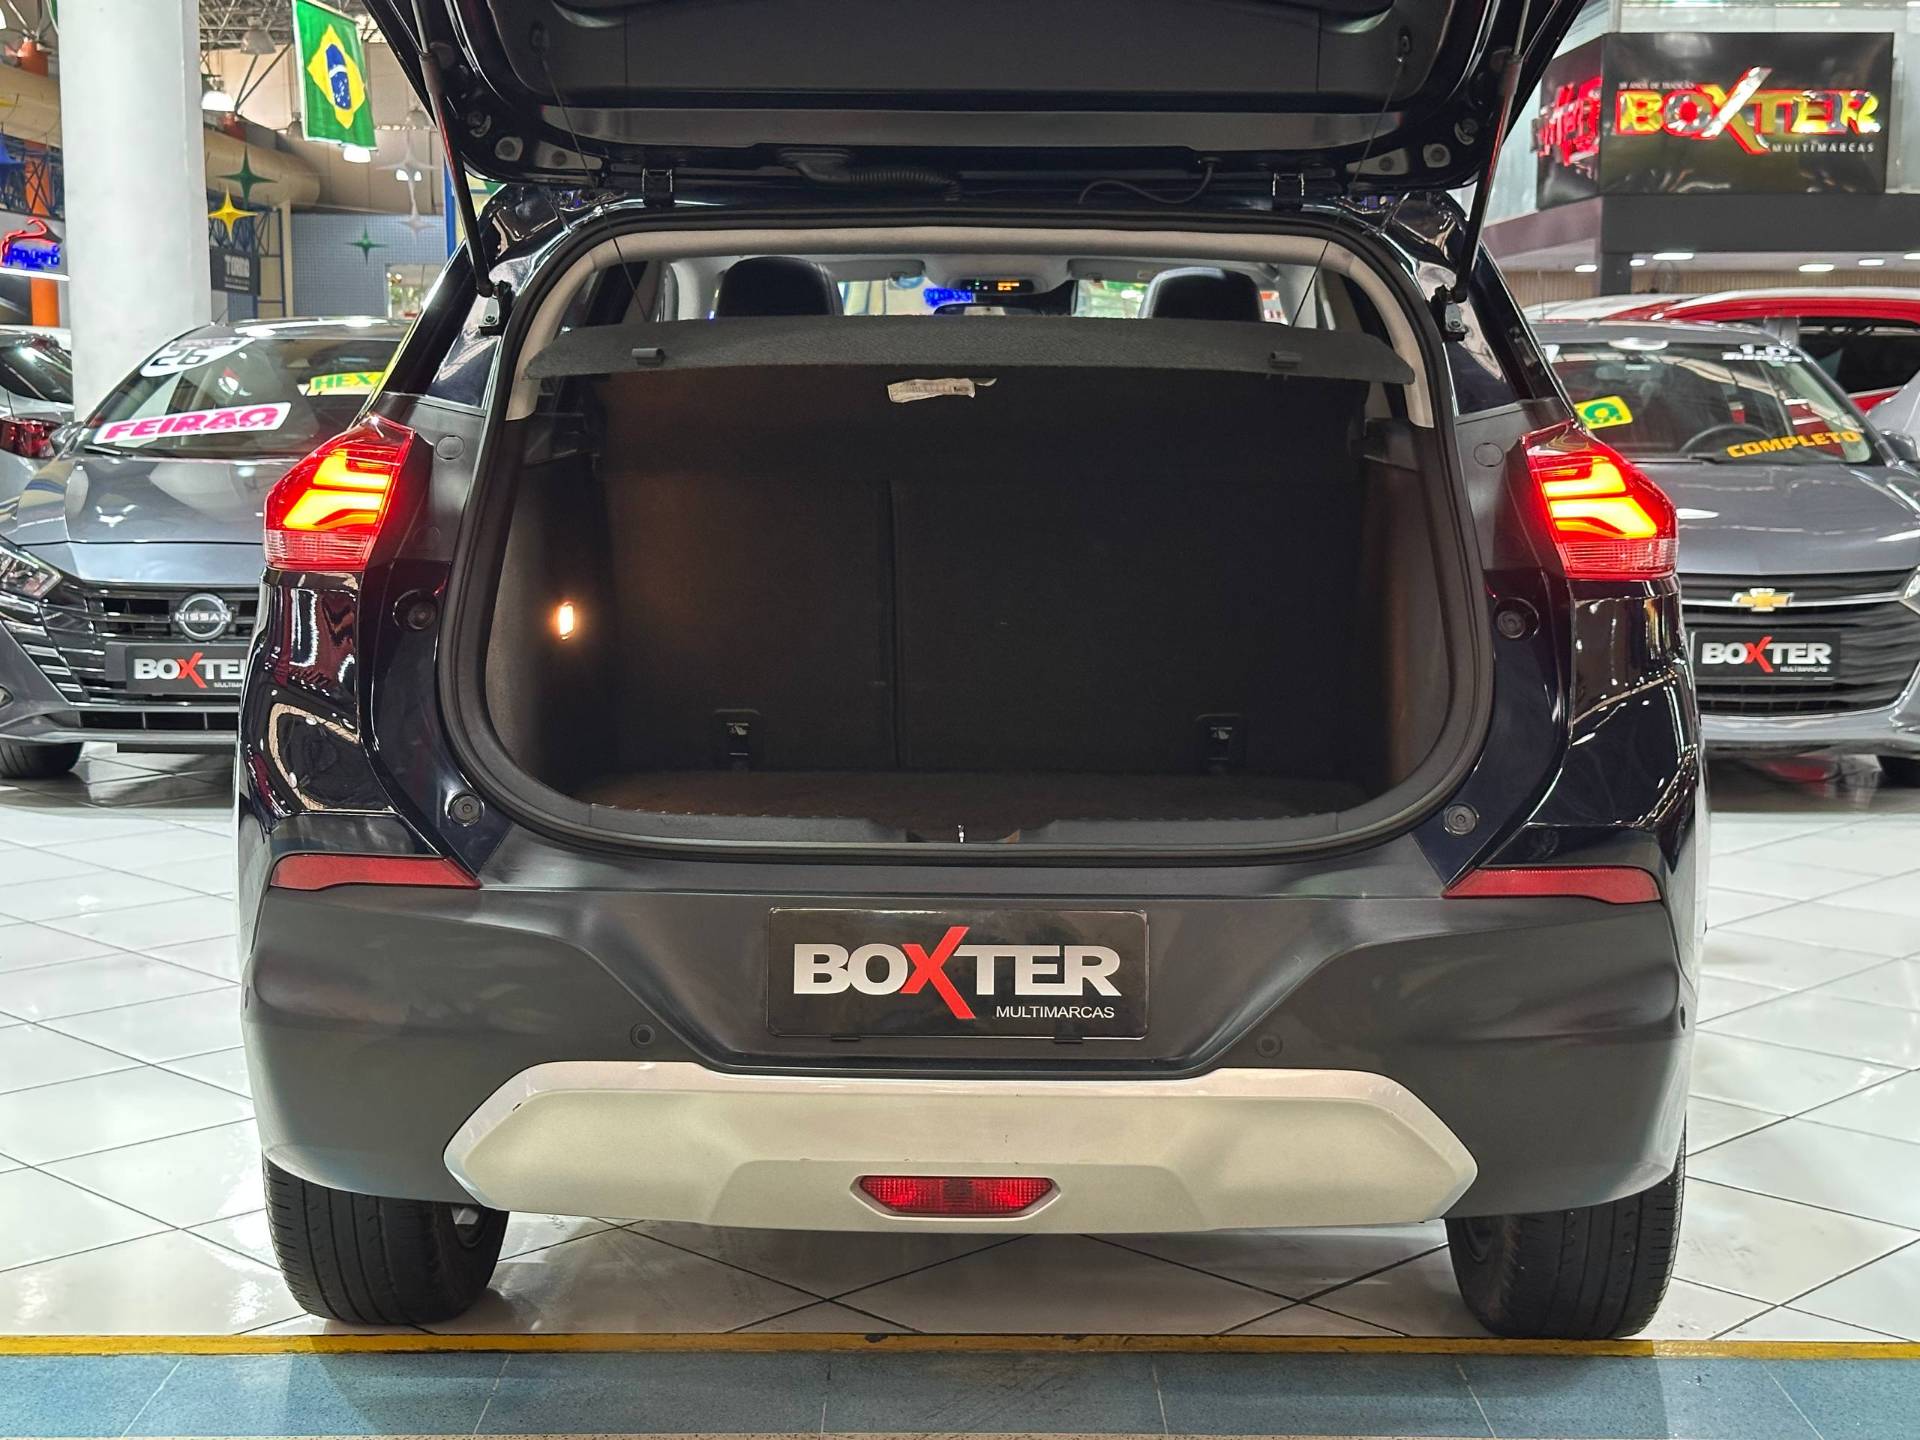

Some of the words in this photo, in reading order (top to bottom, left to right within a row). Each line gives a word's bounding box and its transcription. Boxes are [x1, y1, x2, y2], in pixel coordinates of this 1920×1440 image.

[1615, 66, 1881, 155] BOXTER
[1772, 142, 1875, 153] MULTIMARCAS
[104, 407, 279, 440] FEIRÃO
[1727, 431, 1862, 458] COMPLETO
[175, 610, 232, 622] NISSAN
[1701, 635, 1832, 673] BOXTER
[793, 925, 1122, 1020] BOXTER
[996, 1005, 1115, 1019] MULTIMARCAS
